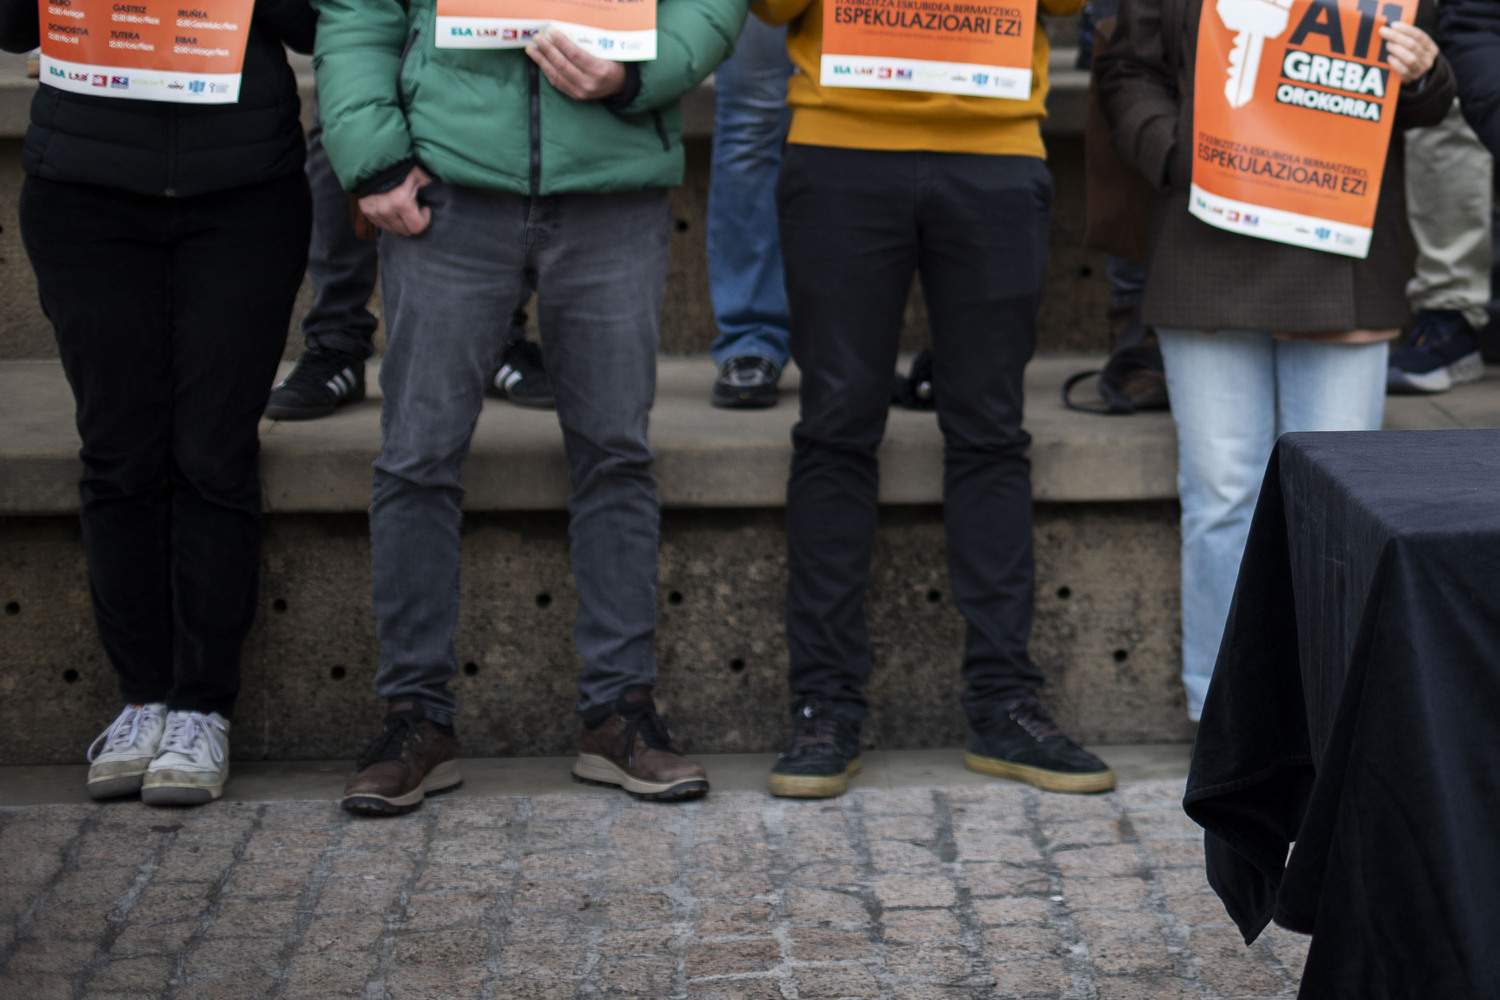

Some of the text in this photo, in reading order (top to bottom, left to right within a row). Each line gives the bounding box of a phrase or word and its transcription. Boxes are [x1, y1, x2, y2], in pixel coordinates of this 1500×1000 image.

[834, 6, 1022, 36] ESPEKULAZIOARI EZ!
[1283, 50, 1385, 98] GREBA
[1276, 84, 1381, 122] OROKORRA
[1198, 143, 1368, 196] ESPEKULAZIOARI EZ!
